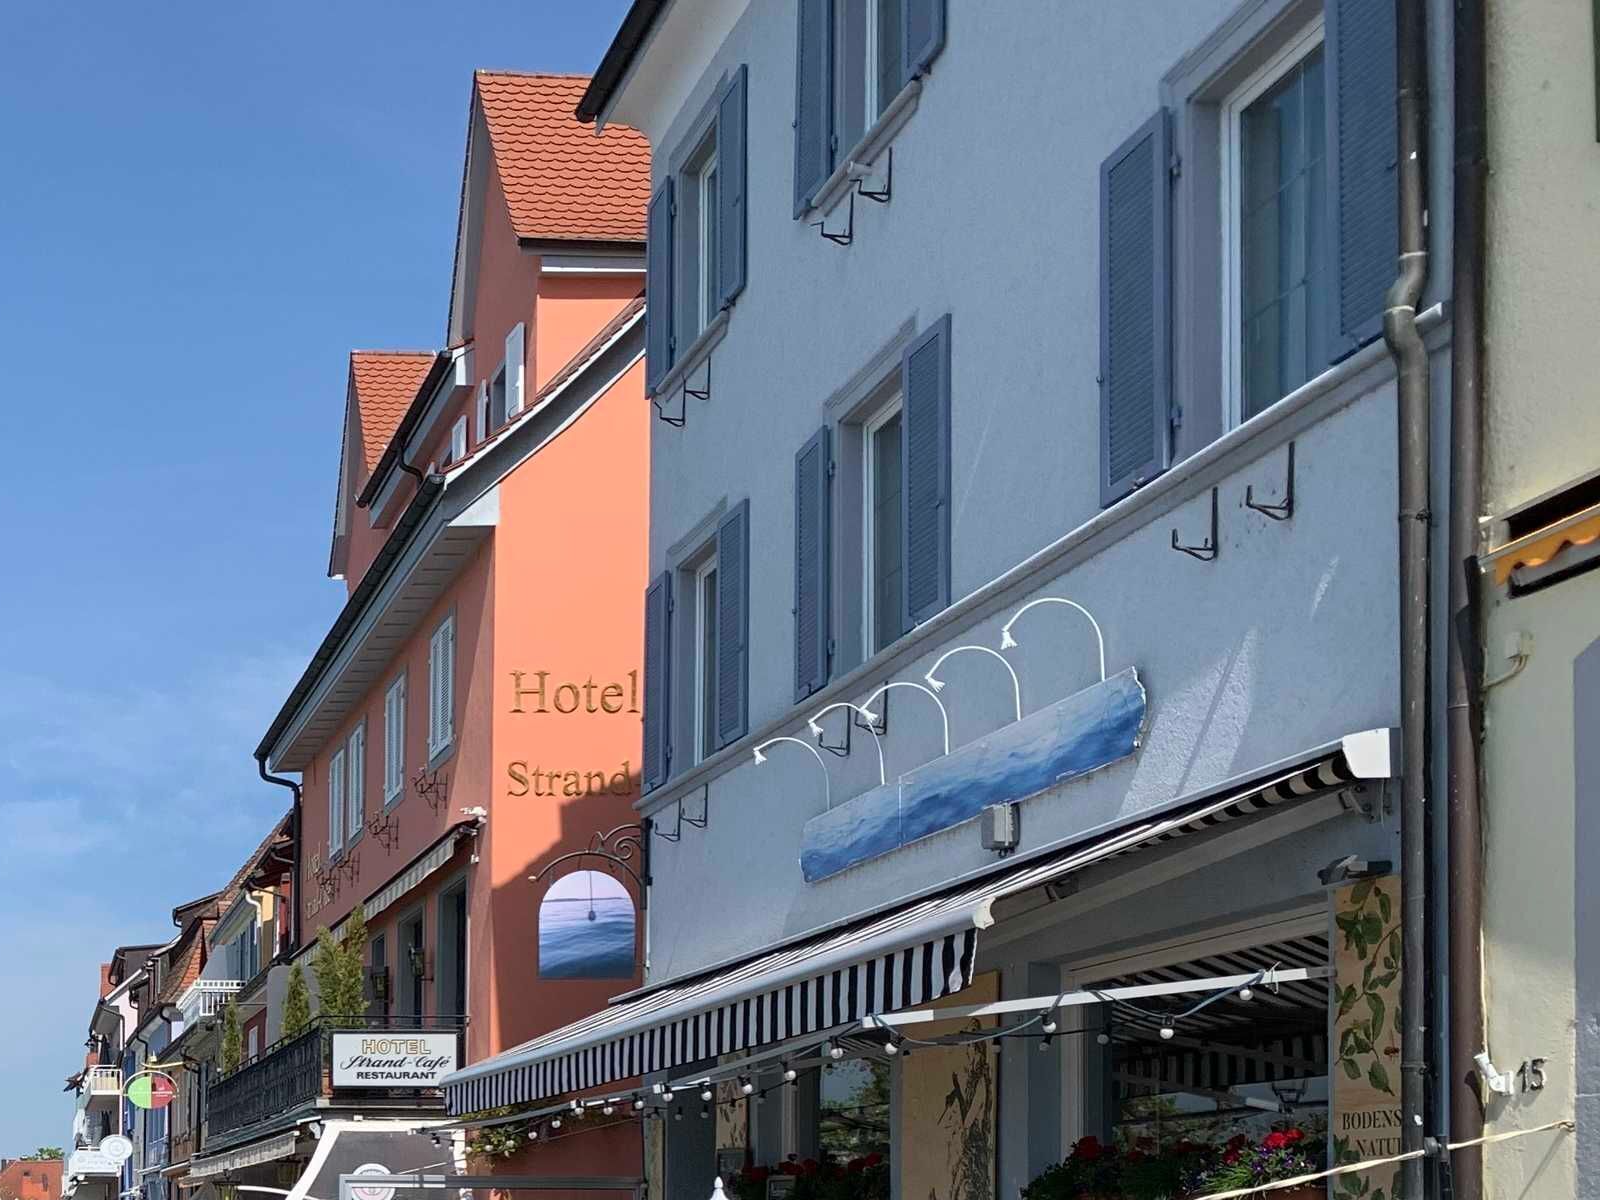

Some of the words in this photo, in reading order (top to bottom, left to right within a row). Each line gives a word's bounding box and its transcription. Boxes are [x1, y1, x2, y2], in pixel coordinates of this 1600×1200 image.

[508, 669, 641, 714] Hotel
[361, 1039, 432, 1055] HOTEL
[356, 1071, 438, 1080] RESTAURANT
[1516, 1058, 1548, 1094] 15
[1356, 1137, 1401, 1156] NATU
